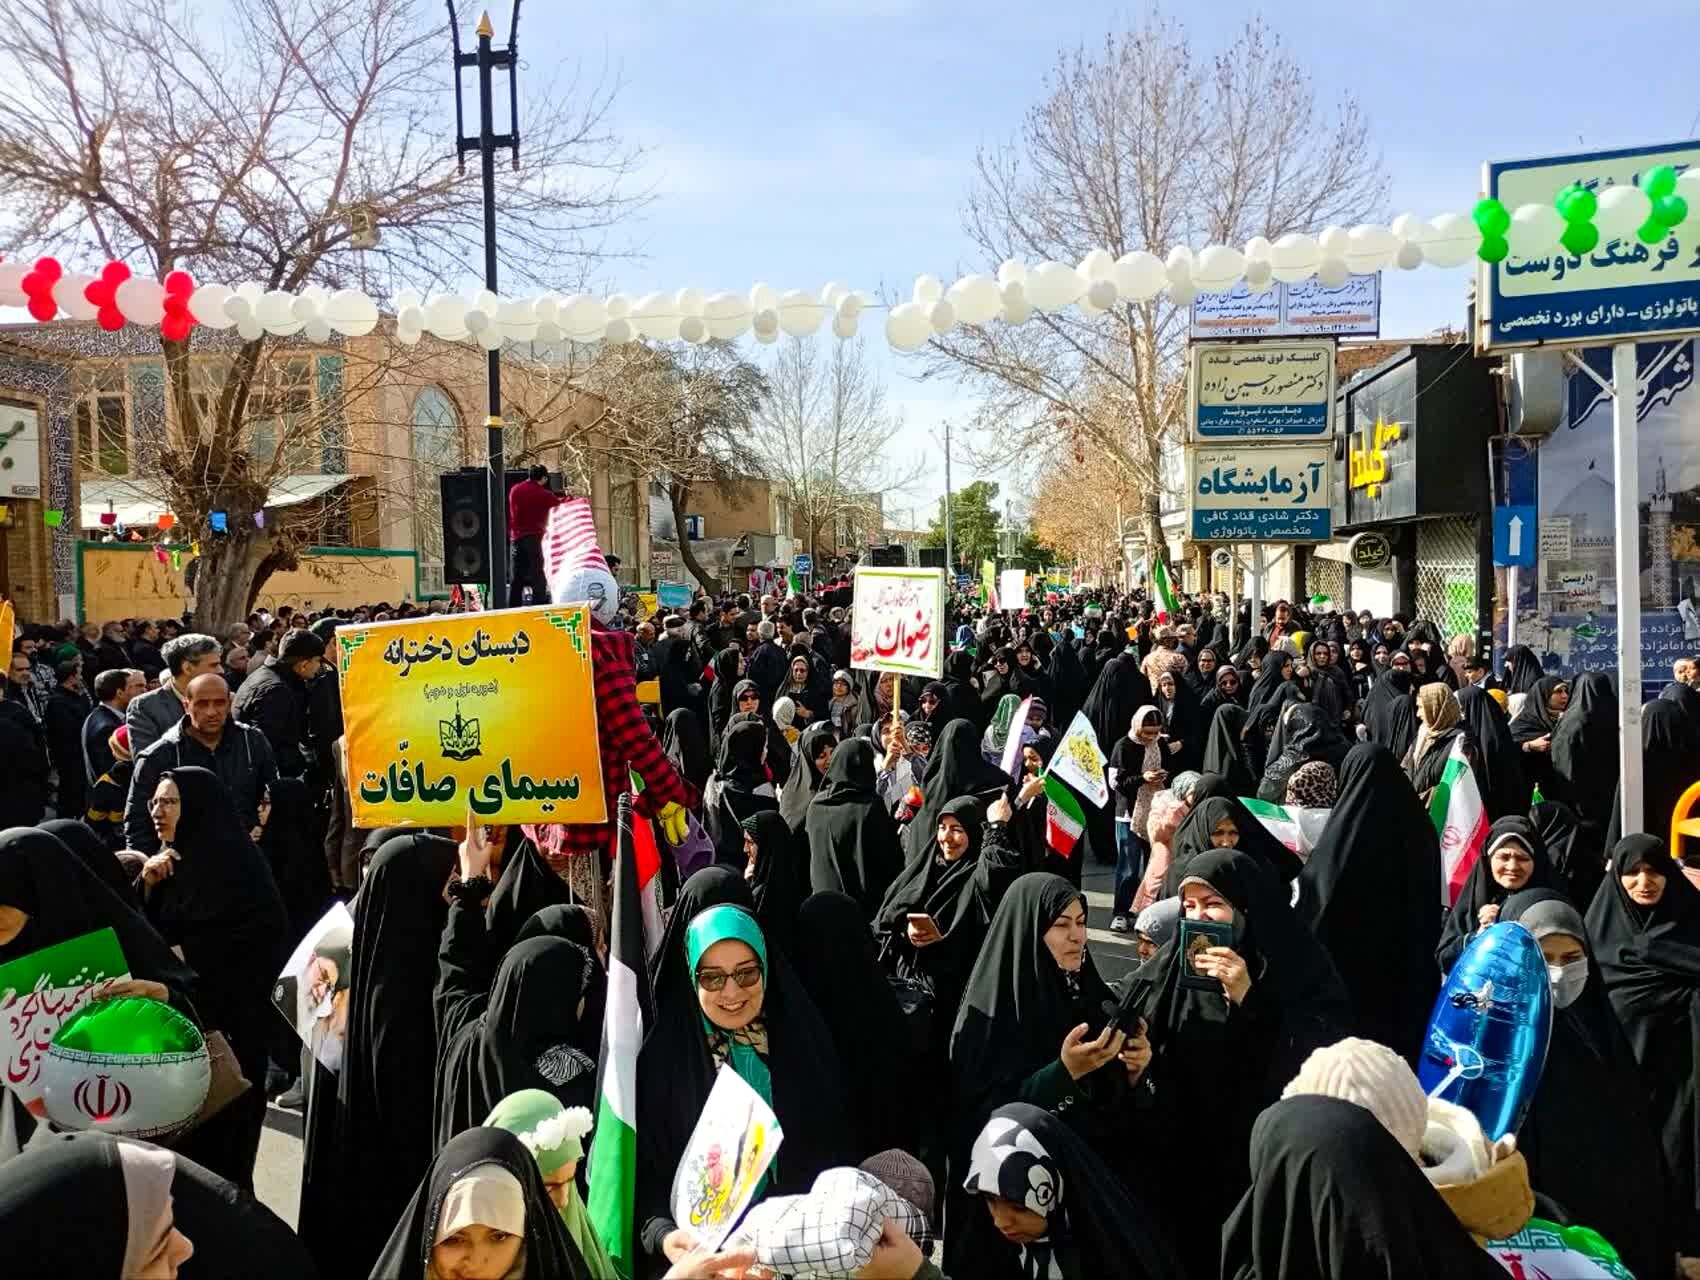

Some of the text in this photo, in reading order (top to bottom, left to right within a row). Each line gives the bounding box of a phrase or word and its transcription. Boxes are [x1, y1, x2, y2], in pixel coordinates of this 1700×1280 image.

[1499, 311, 1550, 333] تخصصی
[1553, 312, 1583, 329] بورد
[1586, 305, 1625, 326] دارای
[1233, 354, 1266, 366] تخصصی
[1296, 370, 1325, 399] دکتر
[1198, 461, 1326, 504] آزمایشگاه
[1258, 510, 1289, 523] شادی
[1293, 510, 1320, 523] دکتر
[1209, 526, 1312, 539] متخصص پاتولوژی
[875, 609, 932, 661] رضوان
[383, 628, 530, 677] دبستان دخترانه
[469, 757, 581, 815] سیمای
